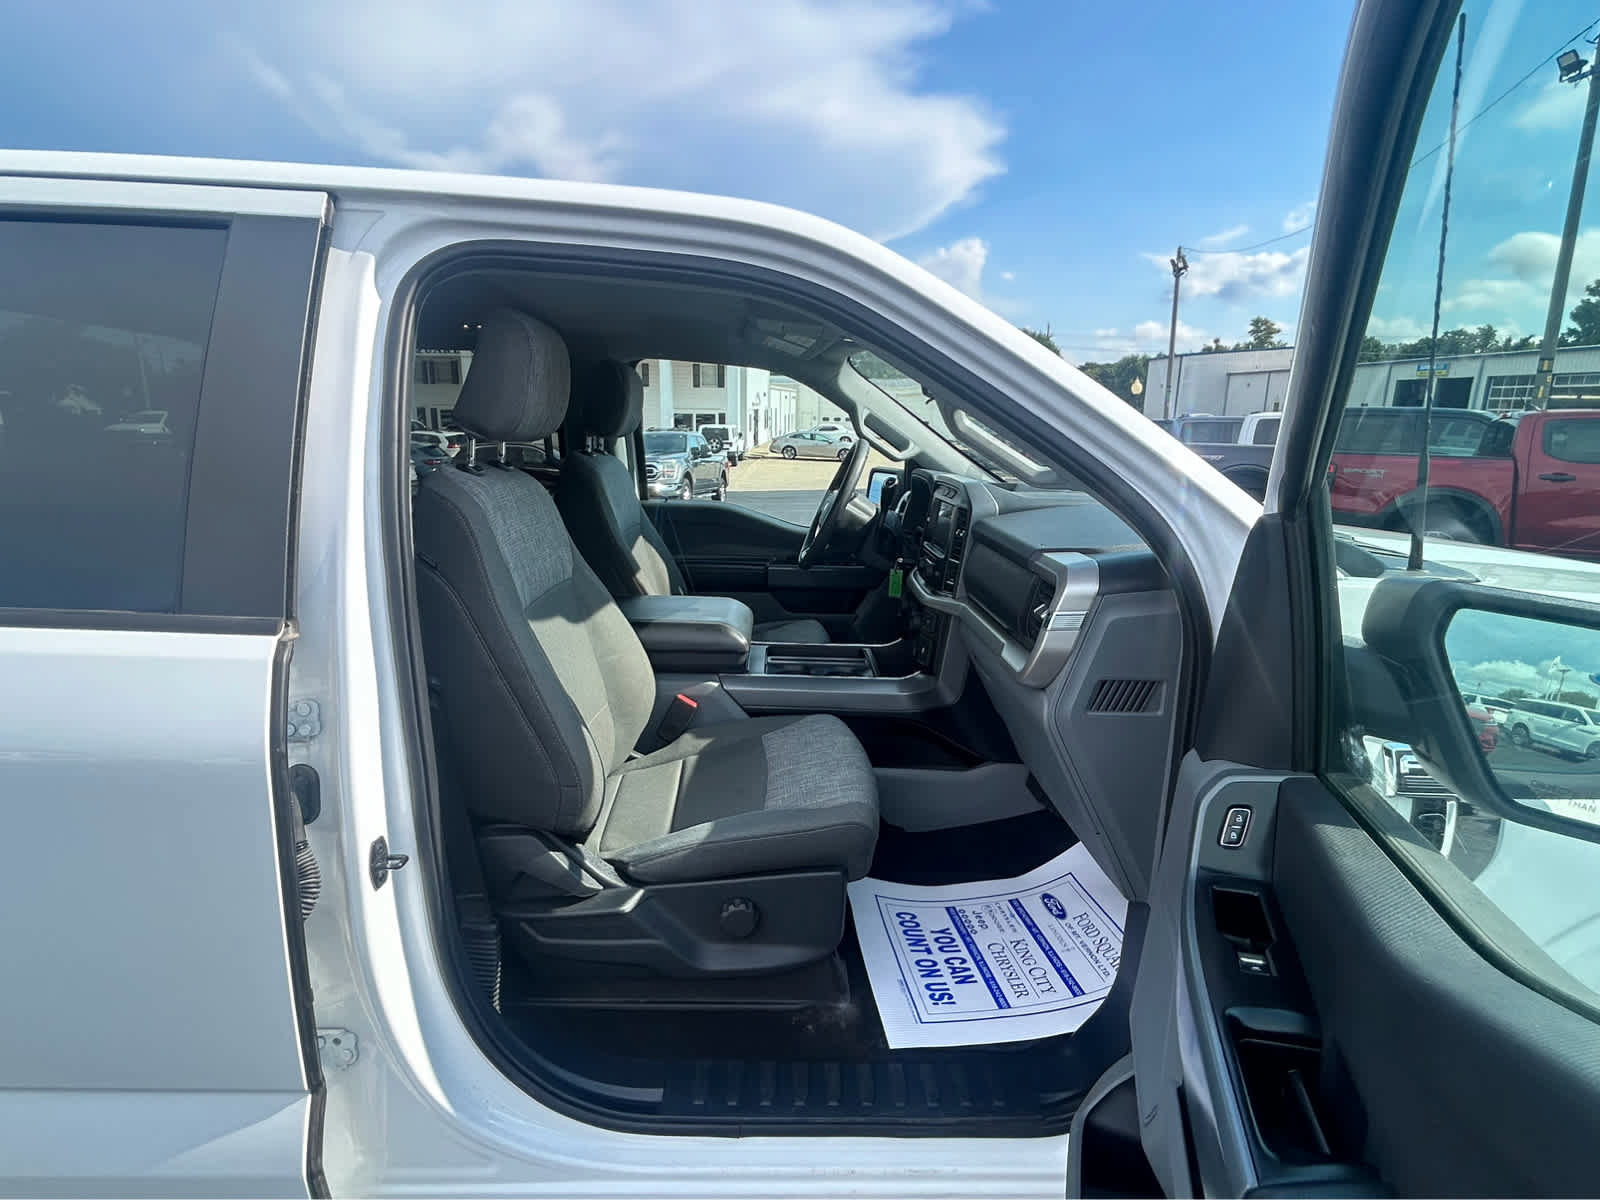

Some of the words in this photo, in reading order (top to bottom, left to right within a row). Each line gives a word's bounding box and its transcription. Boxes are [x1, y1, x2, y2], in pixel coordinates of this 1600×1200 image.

[972, 910, 989, 929] Jeep
[1043, 896, 1065, 917] Ford
[896, 912, 933, 955] COUNT
[1073, 912, 1101, 938] FORD
[930, 927, 962, 953] YOU
[1080, 940, 1101, 964] VERNON
[914, 959, 944, 978] ON
[944, 956, 978, 984] CAN
[987, 942, 1030, 998] CHRYSLER
[1010, 938, 1037, 966] KING
[1029, 966, 1057, 993] CITY
[924, 982, 957, 1005] US!
